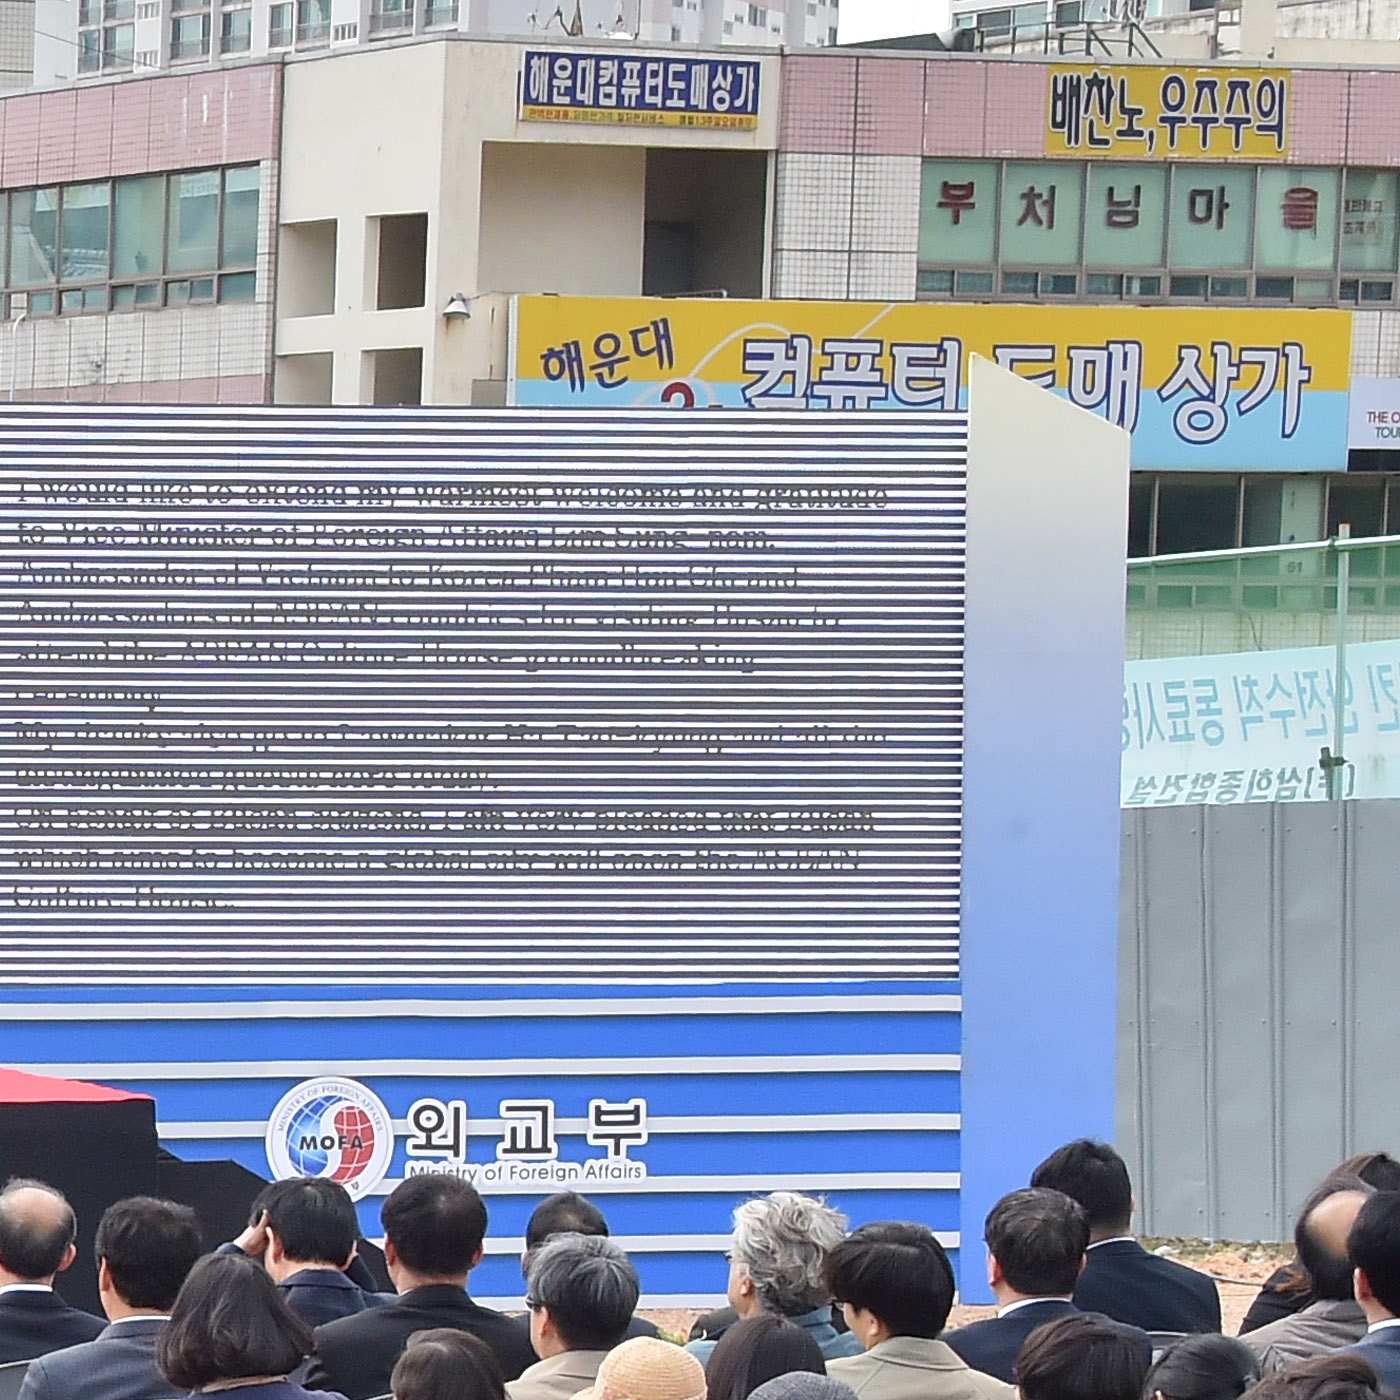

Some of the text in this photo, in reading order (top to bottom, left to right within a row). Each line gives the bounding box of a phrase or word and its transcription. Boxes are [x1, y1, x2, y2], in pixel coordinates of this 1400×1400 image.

[529, 55, 755, 112] 해운대컴퓨터도매상가
[541, 316, 676, 387] 해운대
[1367, 411, 1388, 423] THE
[300, 1135, 363, 1151] MOFA
[484, 1165, 501, 1180] of
[510, 1165, 579, 1182] Foreign
[585, 1163, 642, 1180] Affairs
